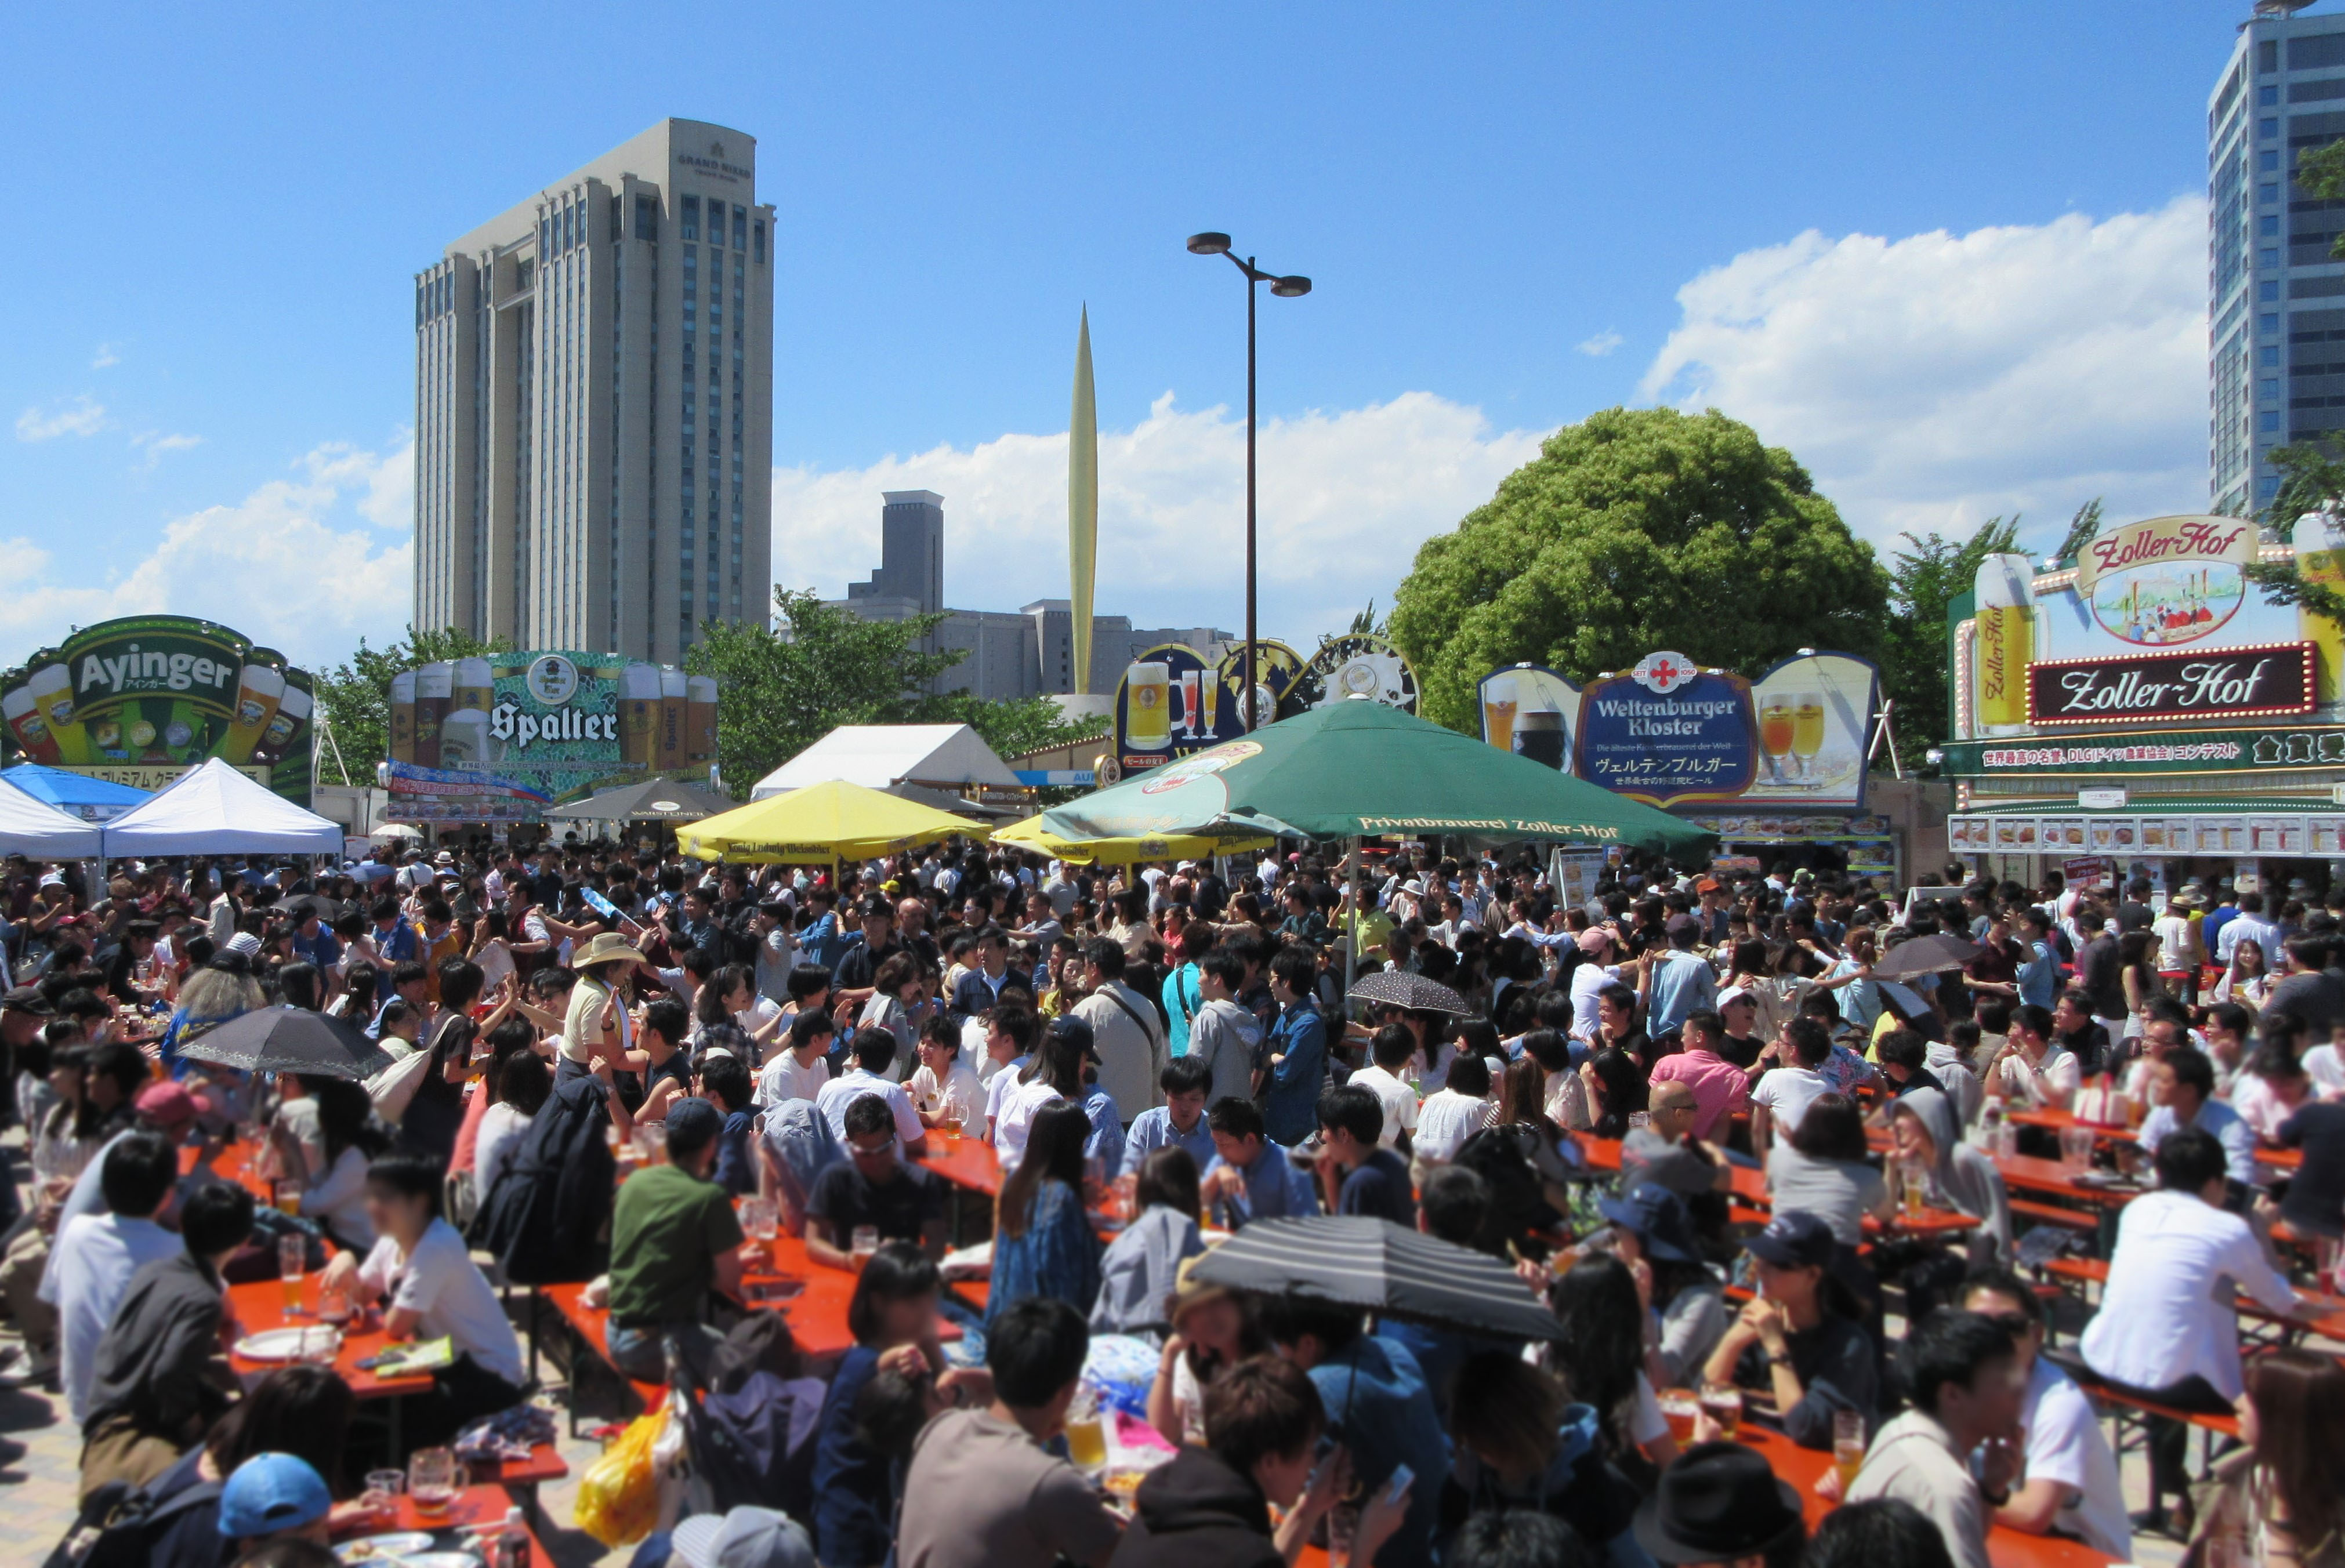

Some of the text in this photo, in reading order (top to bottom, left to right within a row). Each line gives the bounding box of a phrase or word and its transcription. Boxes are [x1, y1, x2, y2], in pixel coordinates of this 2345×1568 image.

[678, 155, 718, 169] GRAND
[2093, 522, 2246, 573] Zoller-Hof
[80, 644, 233, 694] Ayinger
[125, 679, 168, 688] アインガー
[2060, 659, 2272, 713] Zoller-Hof
[1596, 698, 1736, 720] Weltenburger
[488, 702, 618, 749] Spalter
[1628, 718, 1703, 736] Kloster
[1358, 816, 1618, 839] Privatbrauerei Zoller-Hof
[754, 842, 785, 856] Ludwig
